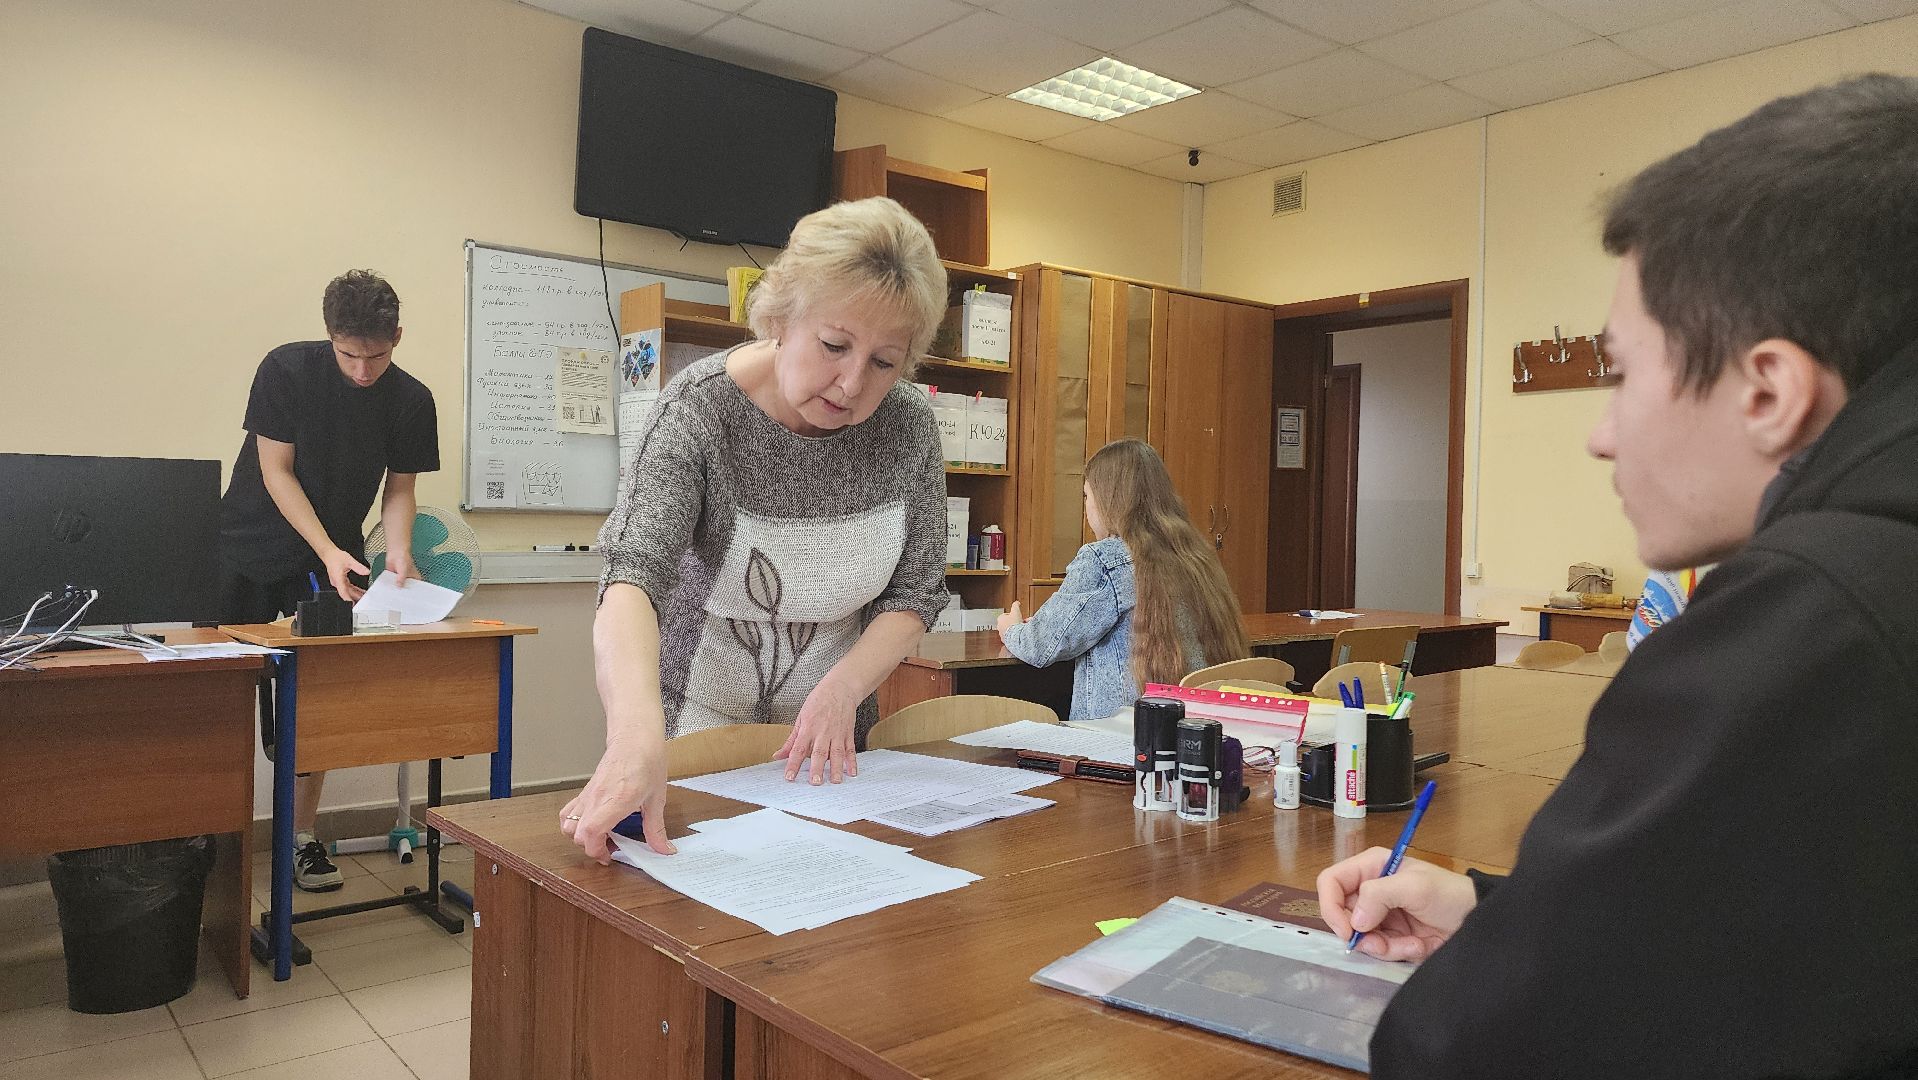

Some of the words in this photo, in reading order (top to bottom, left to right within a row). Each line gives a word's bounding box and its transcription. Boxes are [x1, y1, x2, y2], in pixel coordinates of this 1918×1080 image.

[490, 401, 531, 411] История
[490, 435, 534, 446] Биология
[1347, 771, 1356, 800] attaché
